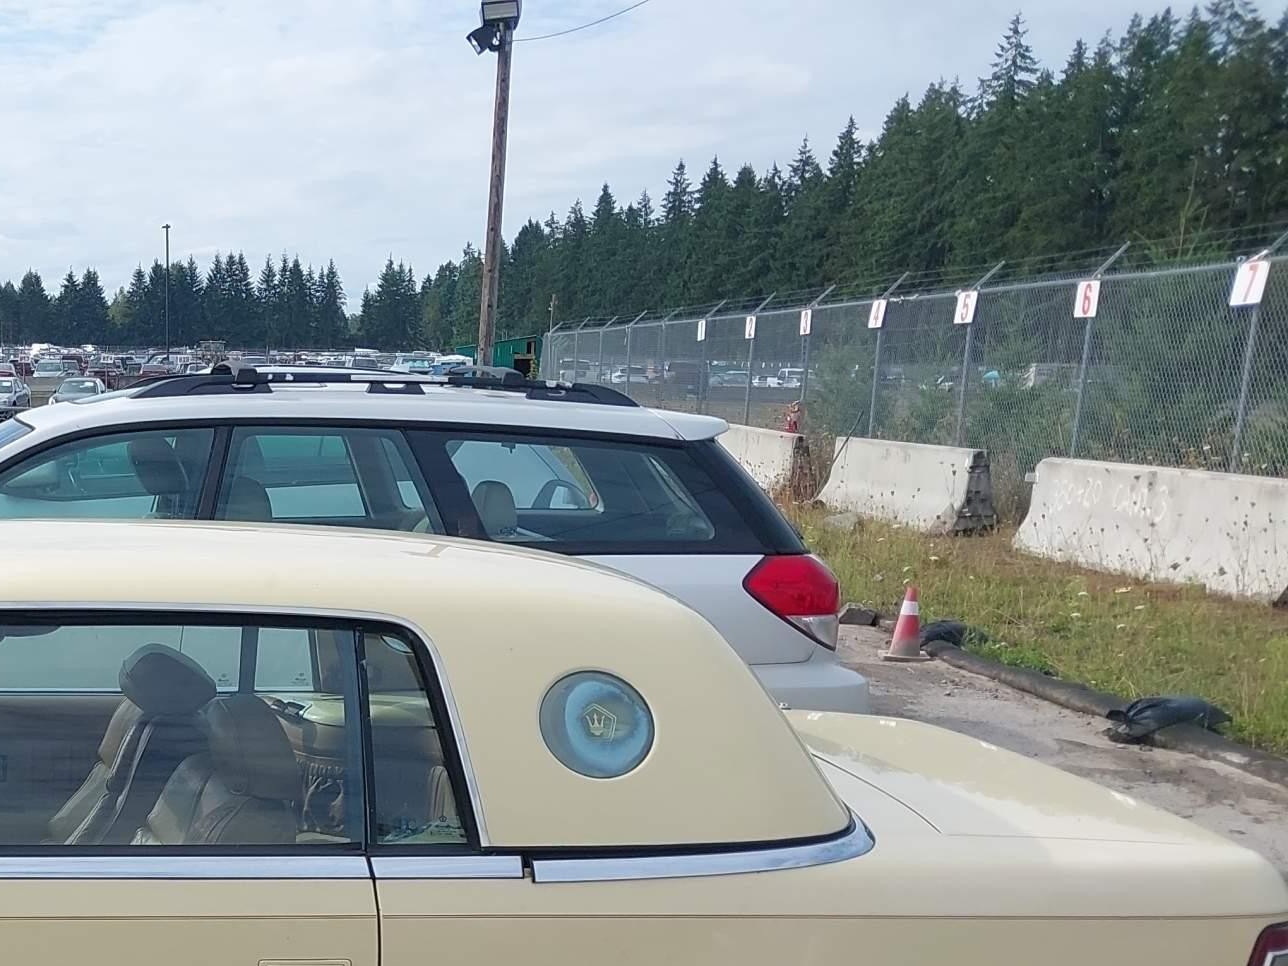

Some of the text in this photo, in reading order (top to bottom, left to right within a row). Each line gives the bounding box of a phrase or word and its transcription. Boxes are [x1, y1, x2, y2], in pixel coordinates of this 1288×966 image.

[1243, 263, 1259, 302] 7
[960, 294, 971, 322] 5
[1081, 283, 1093, 315] 6
[747, 317, 754, 336] 2
[802, 312, 809, 333] 3
[872, 301, 881, 327] 4
